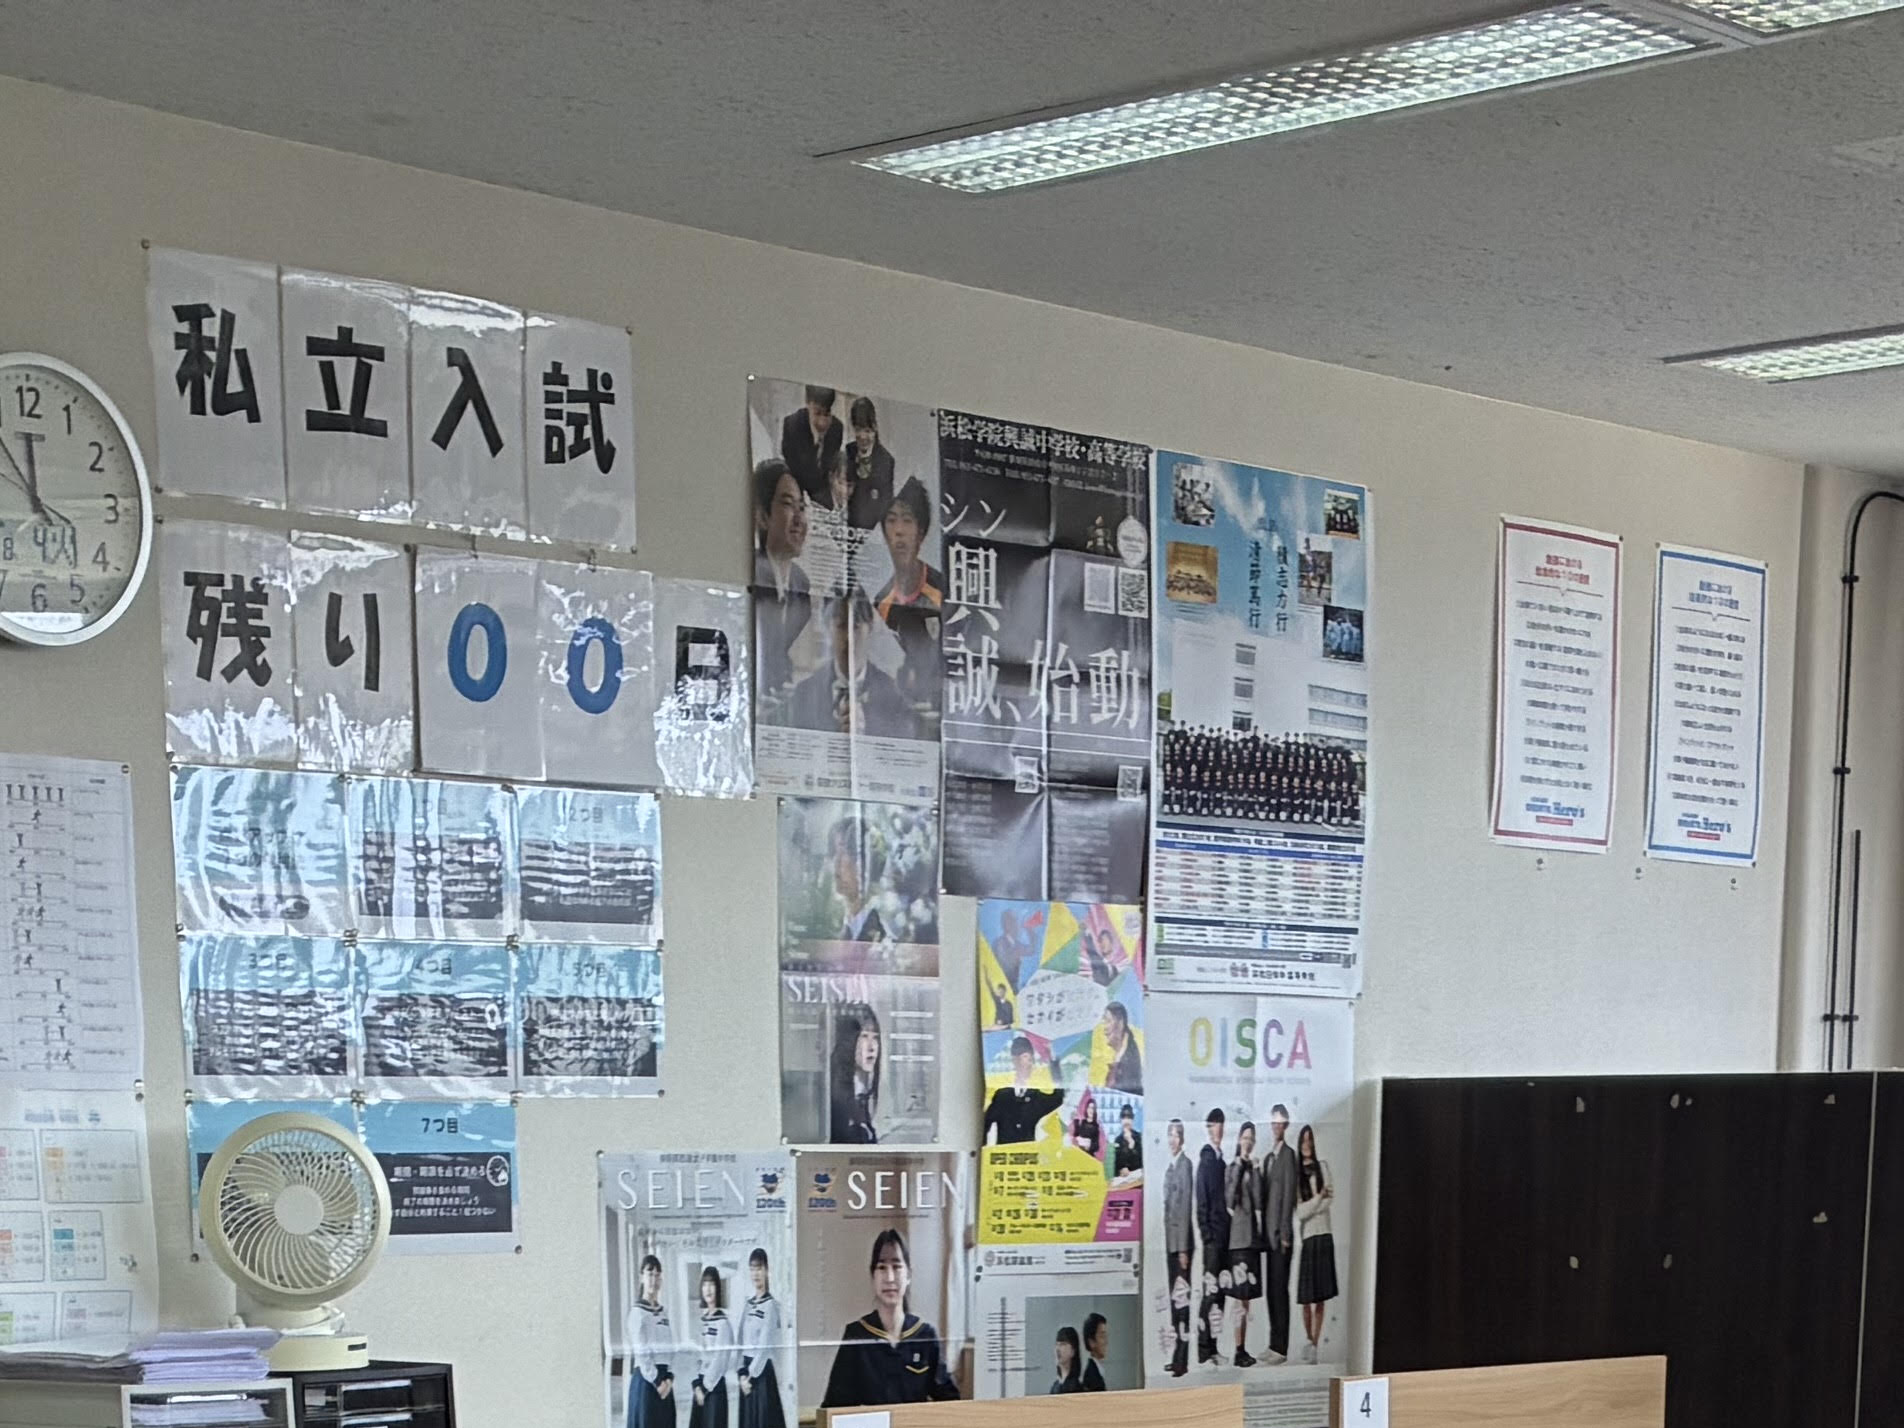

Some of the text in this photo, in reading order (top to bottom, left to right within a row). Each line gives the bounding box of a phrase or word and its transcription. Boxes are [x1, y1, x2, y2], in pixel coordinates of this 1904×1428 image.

[15, 385, 43, 419] 12
[172, 303, 617, 474] 私立入試
[62, 403, 73, 435] 1
[89, 441, 105, 473] 2
[103, 493, 119, 524] 3
[939, 492, 1007, 537] シン
[92, 541, 110, 573] 4
[31, 583, 47, 613] 6
[70, 573, 86, 605] 5
[945, 540, 1003, 632] 興
[183, 570, 732, 722] 残り00日
[1188, 1017, 1313, 1070] OISCA
[421, 1117, 459, 1134] 7つ目
[617, 1169, 746, 1211] SEIEN
[1359, 1391, 1372, 1418] 4
